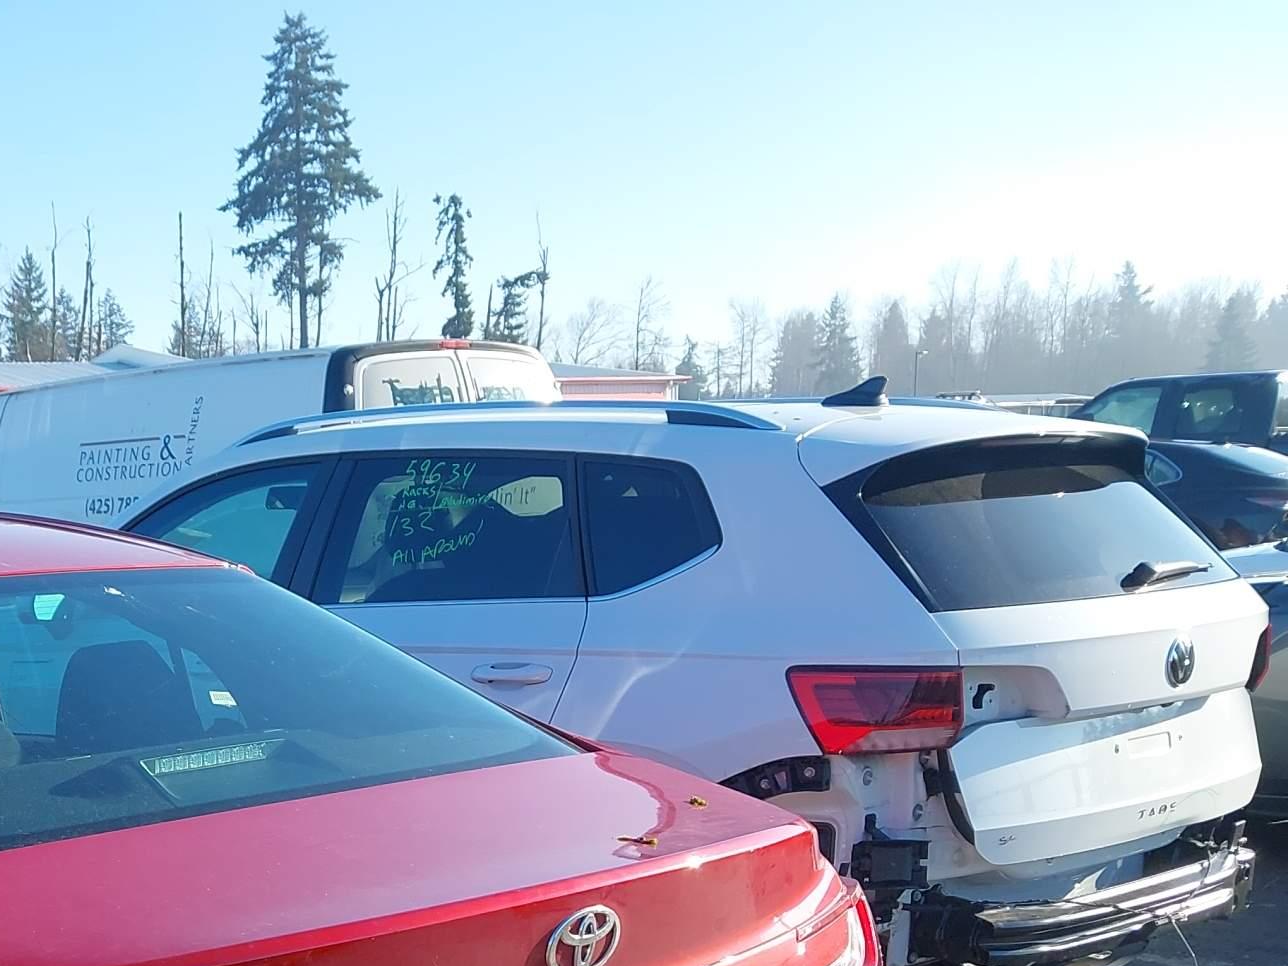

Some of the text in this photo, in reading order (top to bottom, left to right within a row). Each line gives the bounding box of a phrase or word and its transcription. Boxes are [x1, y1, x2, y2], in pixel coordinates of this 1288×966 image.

[79, 434, 177, 466] PAINTING &
[76, 461, 183, 483] CONSTRUCTION
[85, 496, 115, 517] (425)
